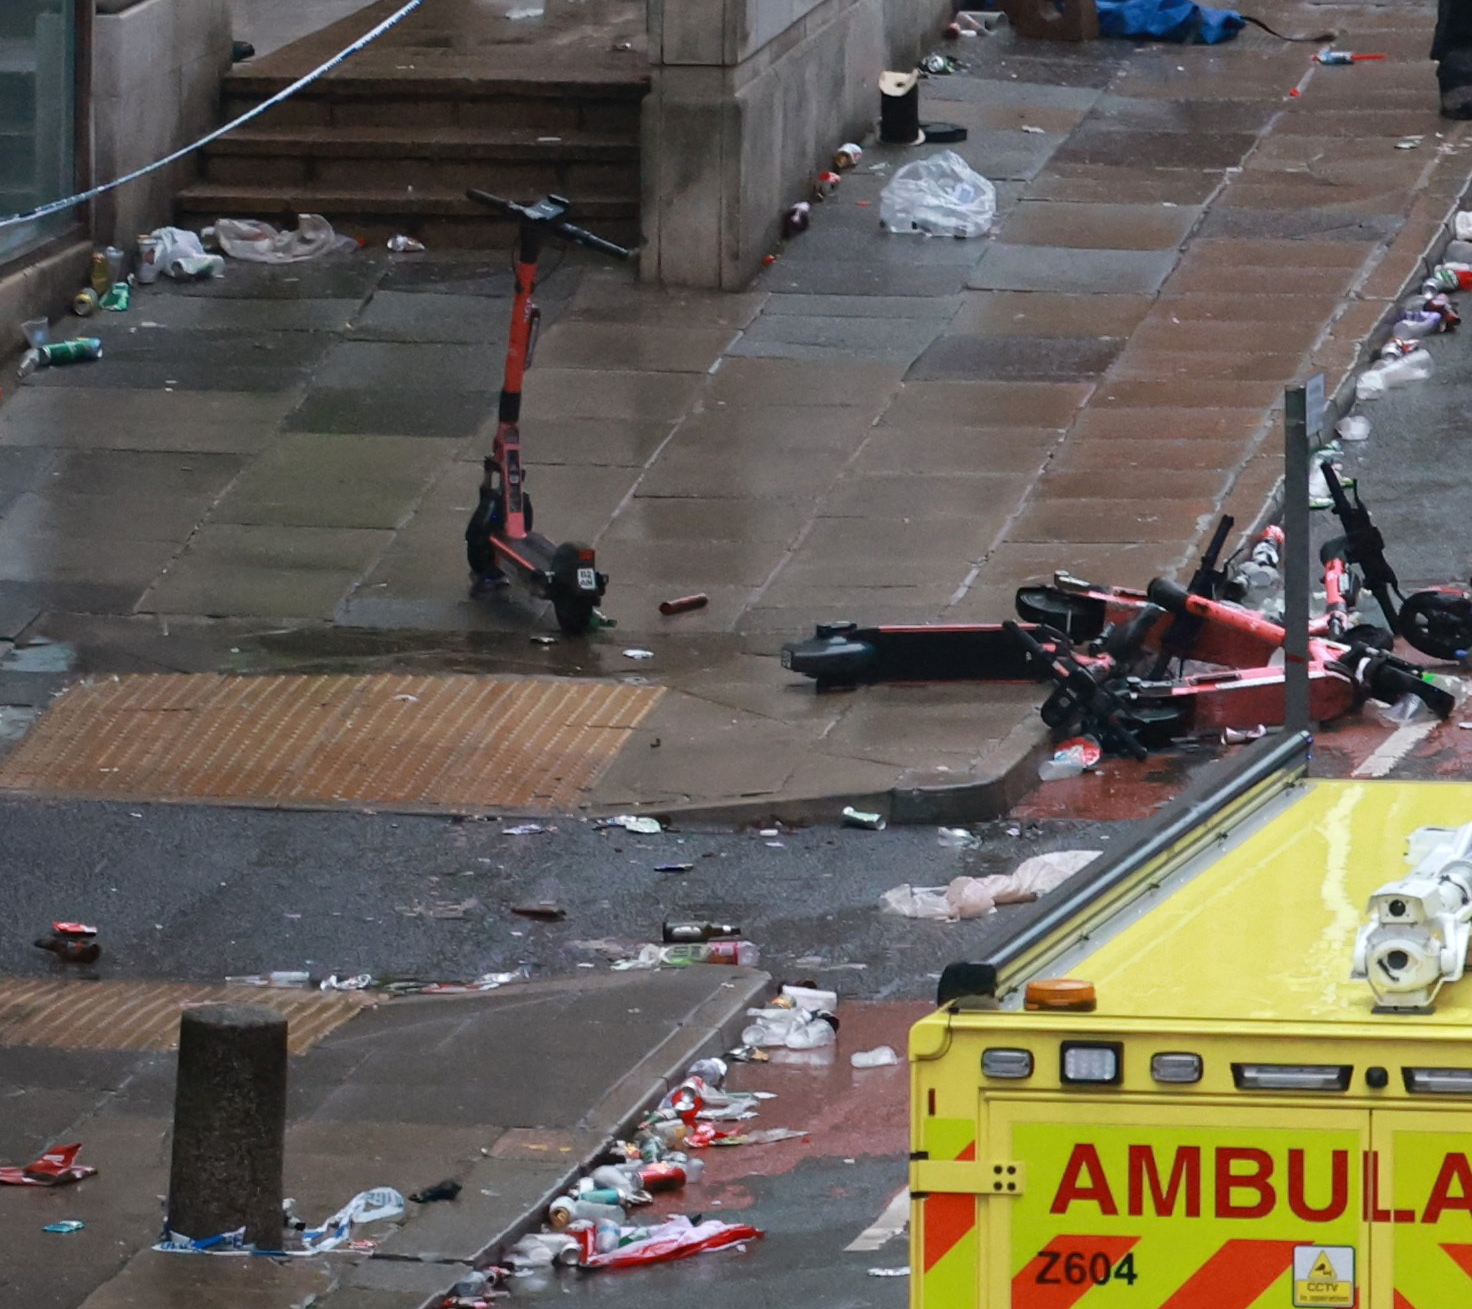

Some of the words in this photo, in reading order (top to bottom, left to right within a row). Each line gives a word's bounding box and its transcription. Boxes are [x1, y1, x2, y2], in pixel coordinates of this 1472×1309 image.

[1035, 1251, 1138, 1286] Z604
[1307, 1282, 1339, 1293] CCTV
[1311, 1294, 1349, 1304] operation
